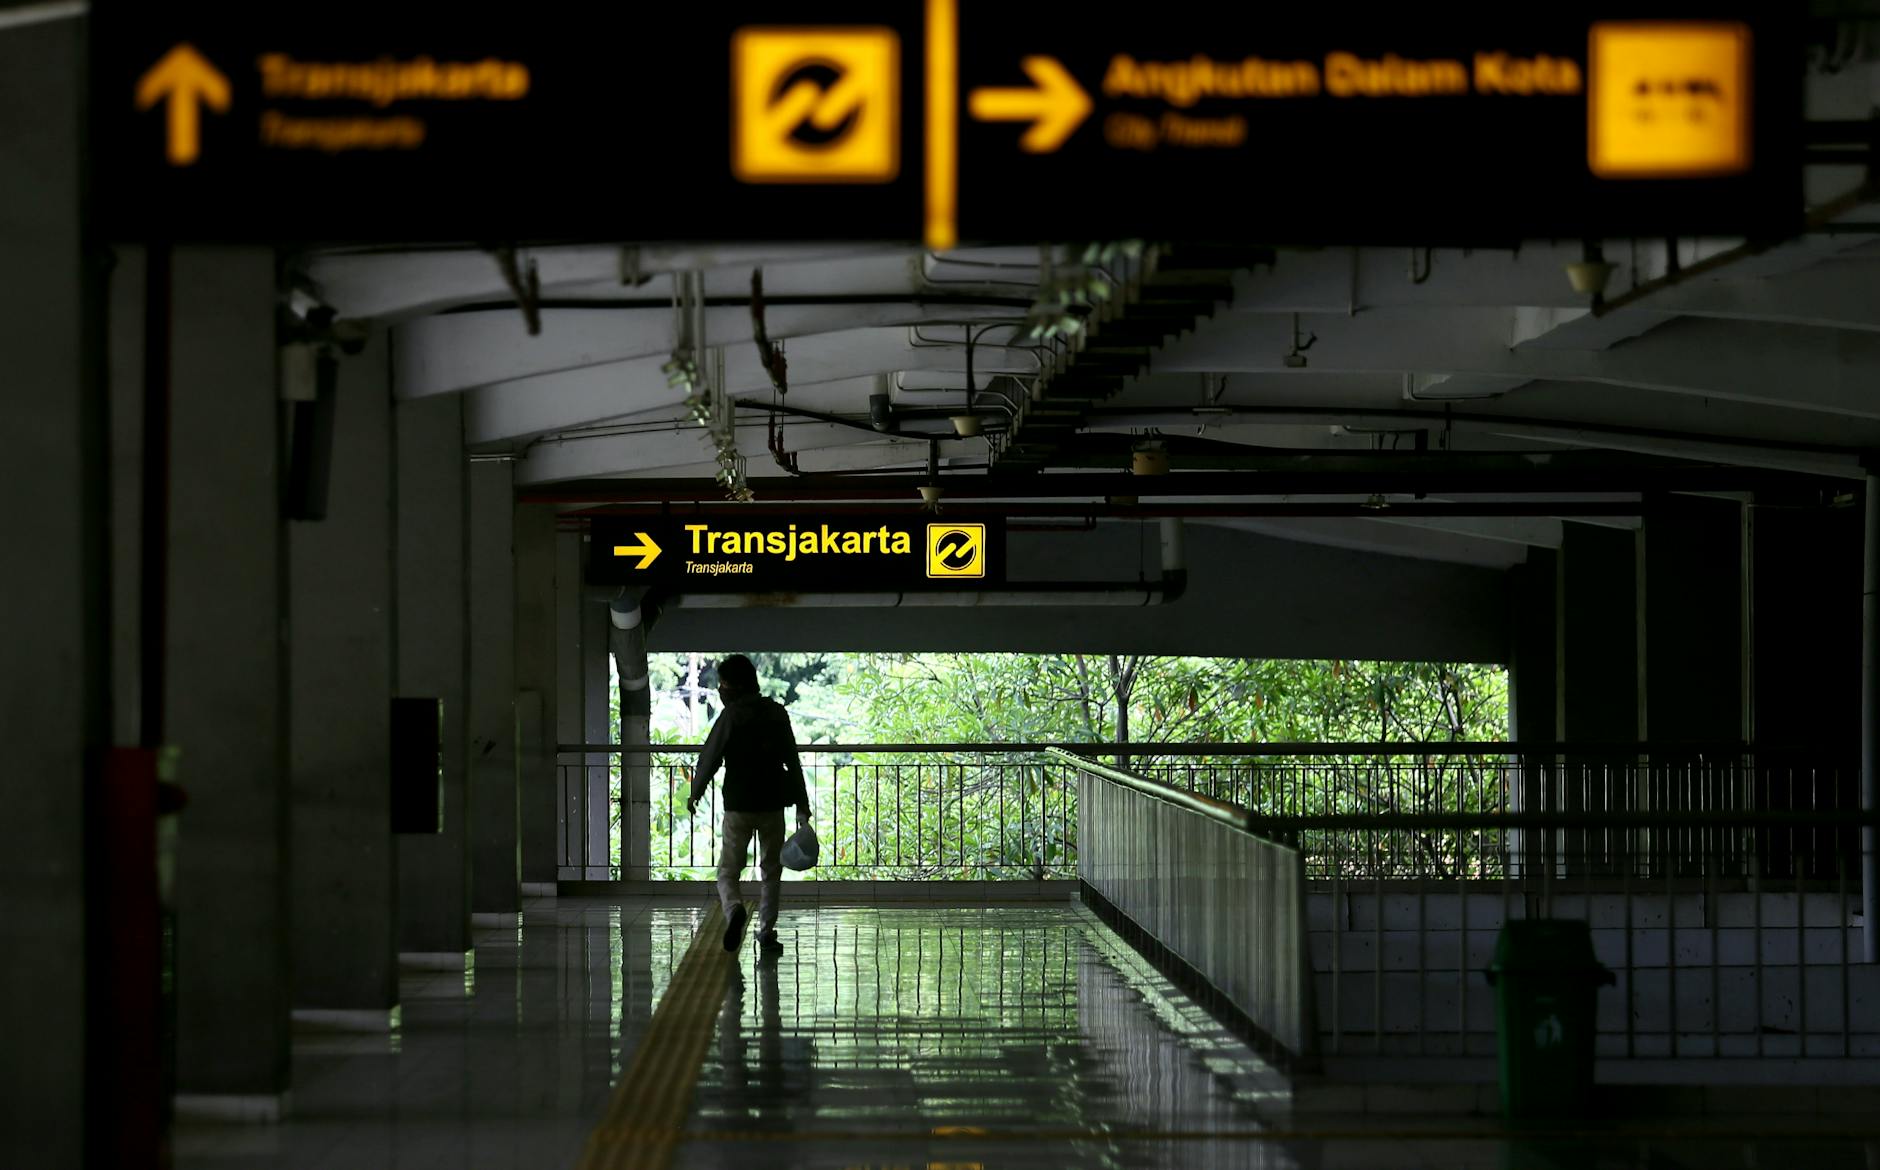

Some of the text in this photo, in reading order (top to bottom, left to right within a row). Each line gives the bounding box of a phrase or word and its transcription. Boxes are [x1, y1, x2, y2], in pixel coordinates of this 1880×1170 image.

[1473, 52, 1582, 95] Kota
[685, 524, 911, 561] Transjakarta
[685, 560, 753, 577] Transjakarta
